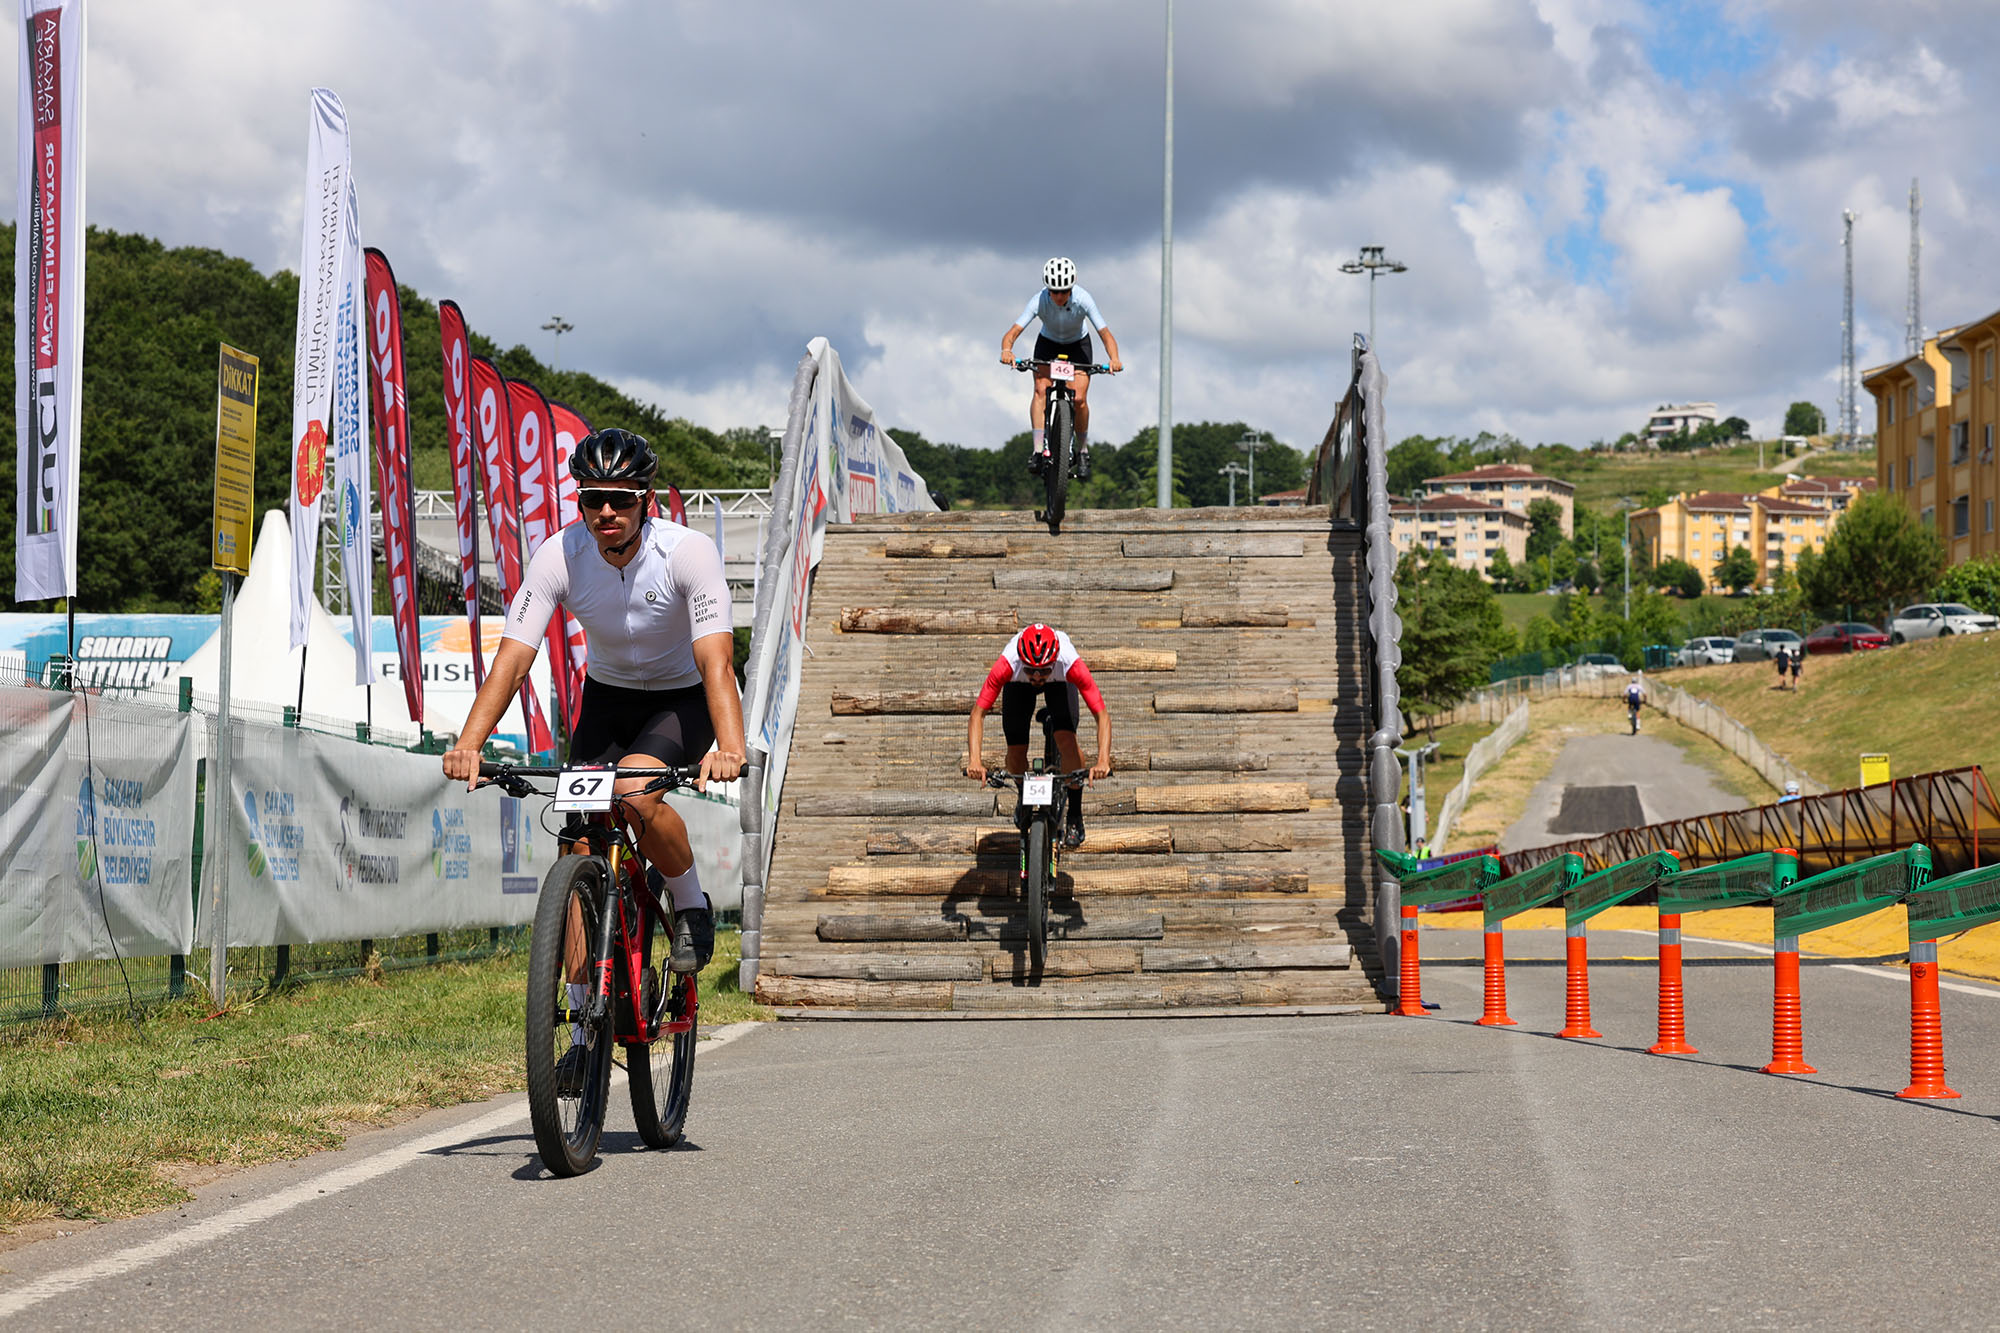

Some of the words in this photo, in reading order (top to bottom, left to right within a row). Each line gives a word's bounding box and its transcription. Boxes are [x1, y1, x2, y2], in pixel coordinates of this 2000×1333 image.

[1055, 365, 1071, 375] 46
[516, 590, 533, 625] DAREVIE
[694, 598, 718, 611] CYCLING
[78, 636, 172, 659] SAKARYA
[568, 777, 604, 796] 67
[1029, 784, 1047, 796] 54
